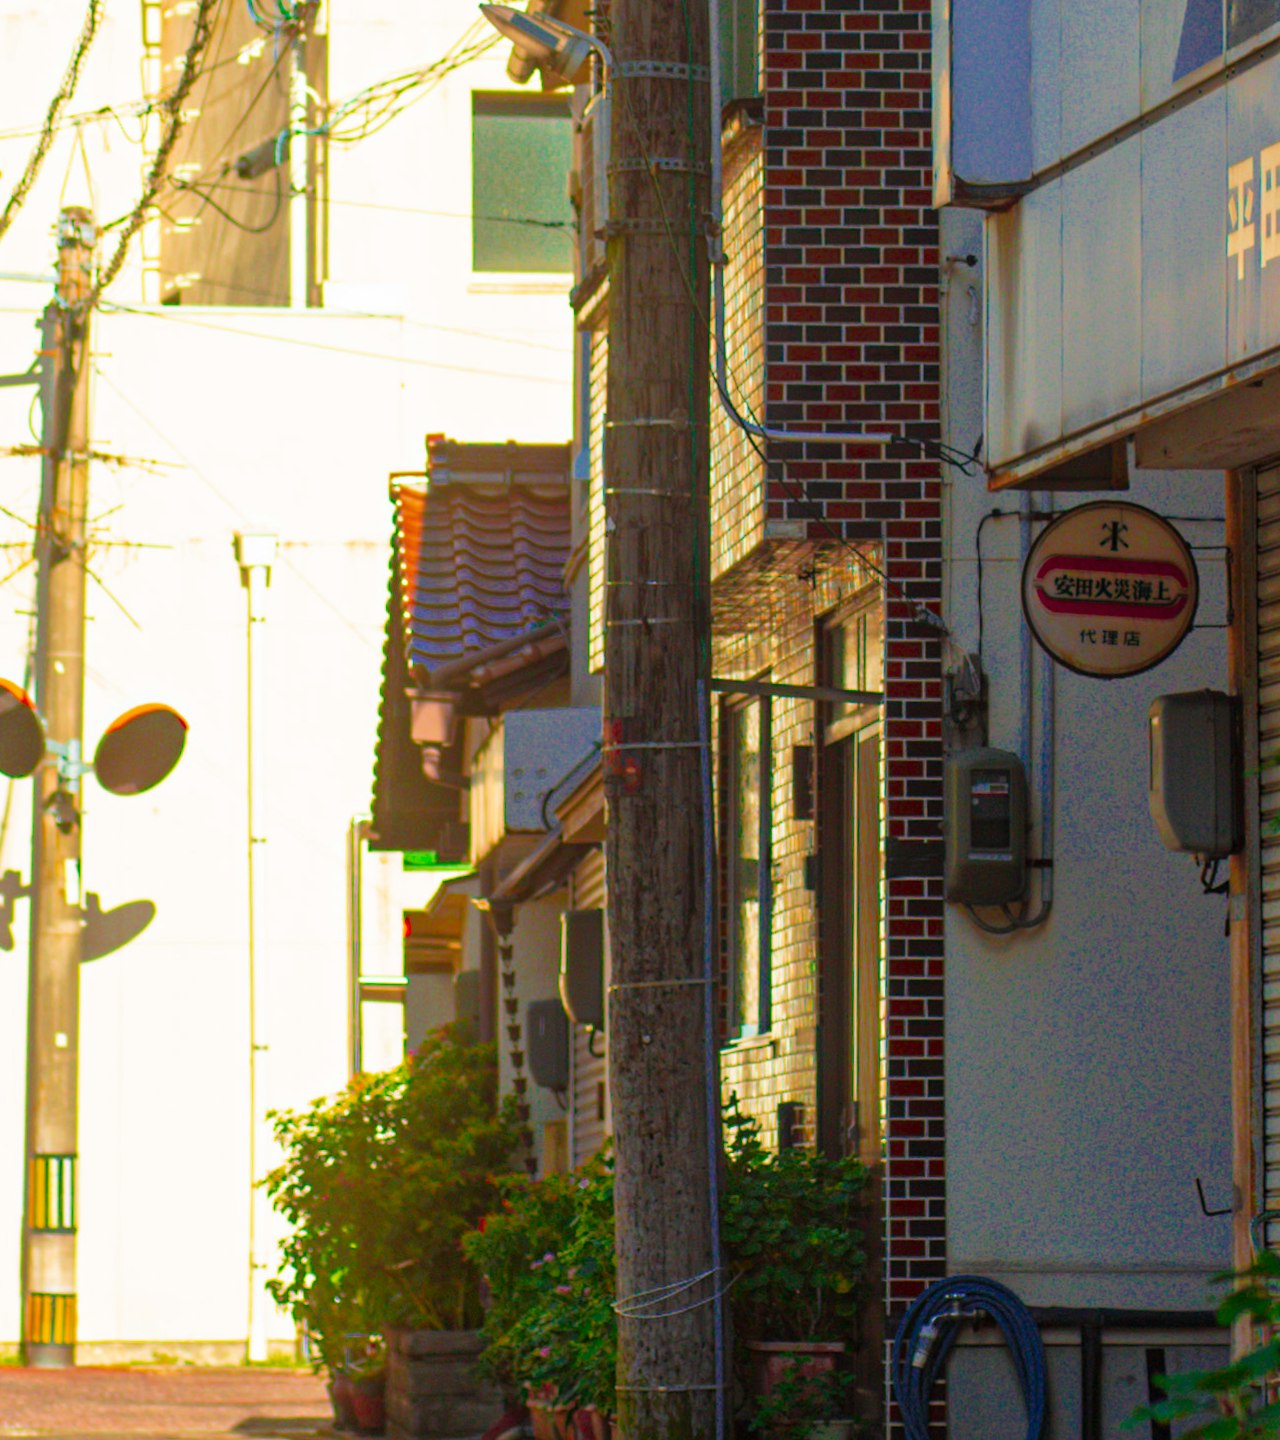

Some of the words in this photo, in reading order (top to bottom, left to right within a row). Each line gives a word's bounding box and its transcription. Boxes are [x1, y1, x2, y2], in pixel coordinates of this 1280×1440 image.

[1053, 575, 1172, 602] 安田火災海上
[1080, 629, 1142, 647] 代理店
